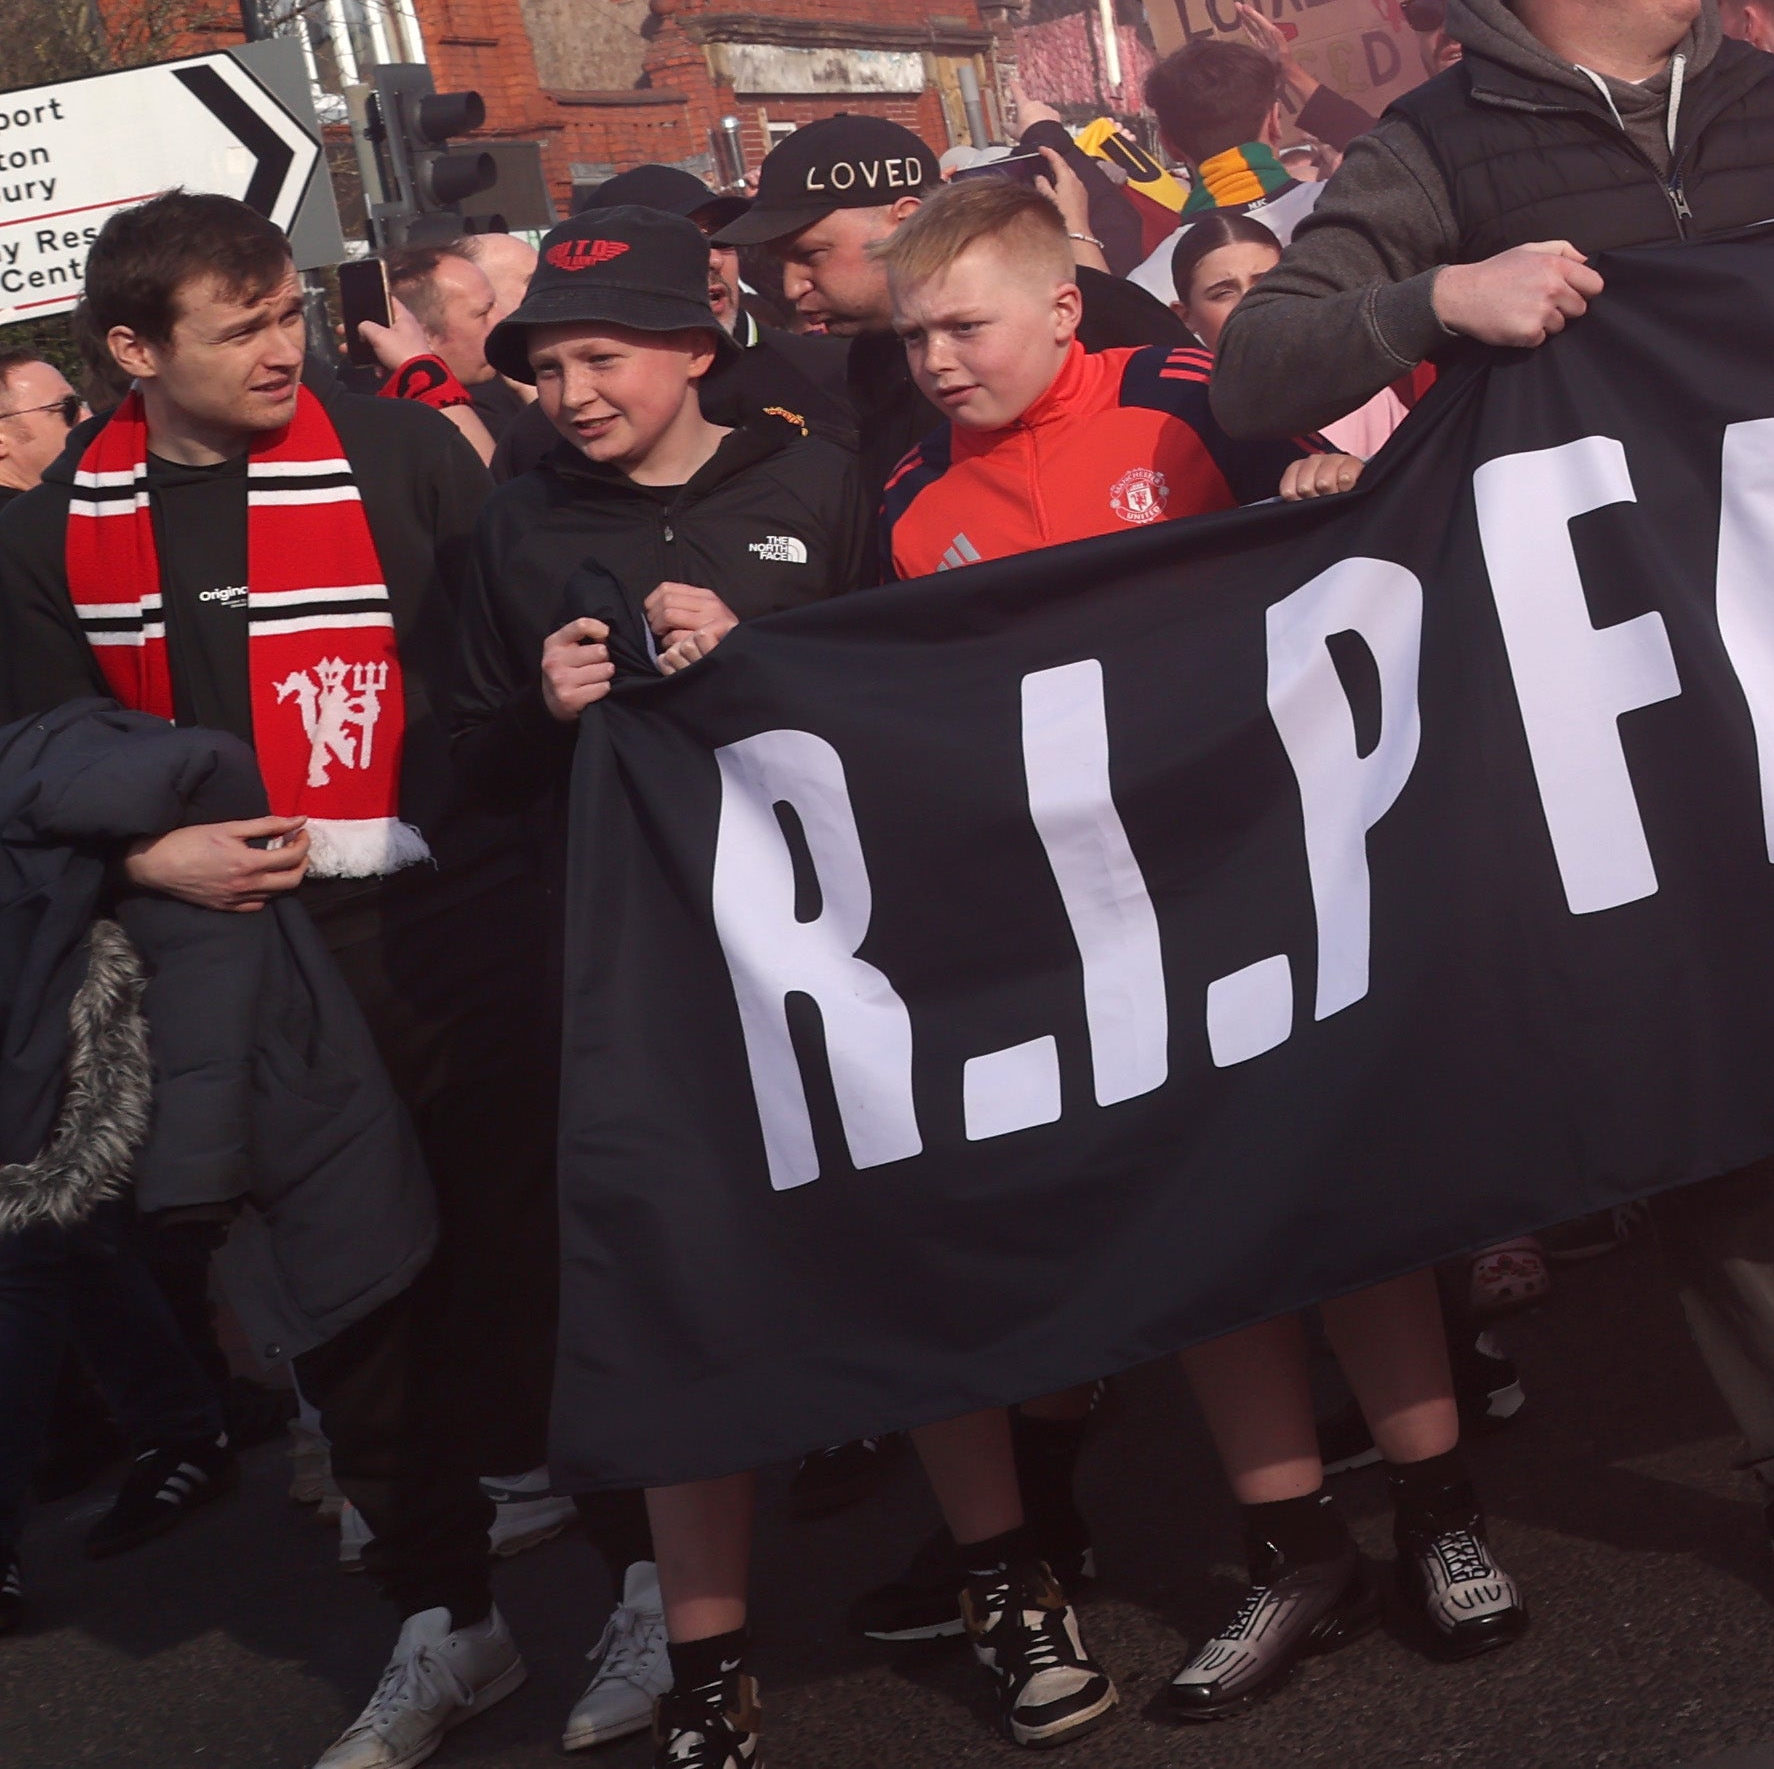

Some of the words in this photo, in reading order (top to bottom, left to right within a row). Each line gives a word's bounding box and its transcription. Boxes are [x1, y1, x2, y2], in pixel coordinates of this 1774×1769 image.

[806, 157, 923, 191] LOVED
[0, 177, 57, 202] ury
[36, 226, 101, 254] Res
[0, 258, 84, 293] Cent
[748, 543, 788, 553] NORTH
[766, 535, 788, 545] THE
[760, 552, 788, 562] FACE
[712, 556, 1424, 1191] R.I.P
